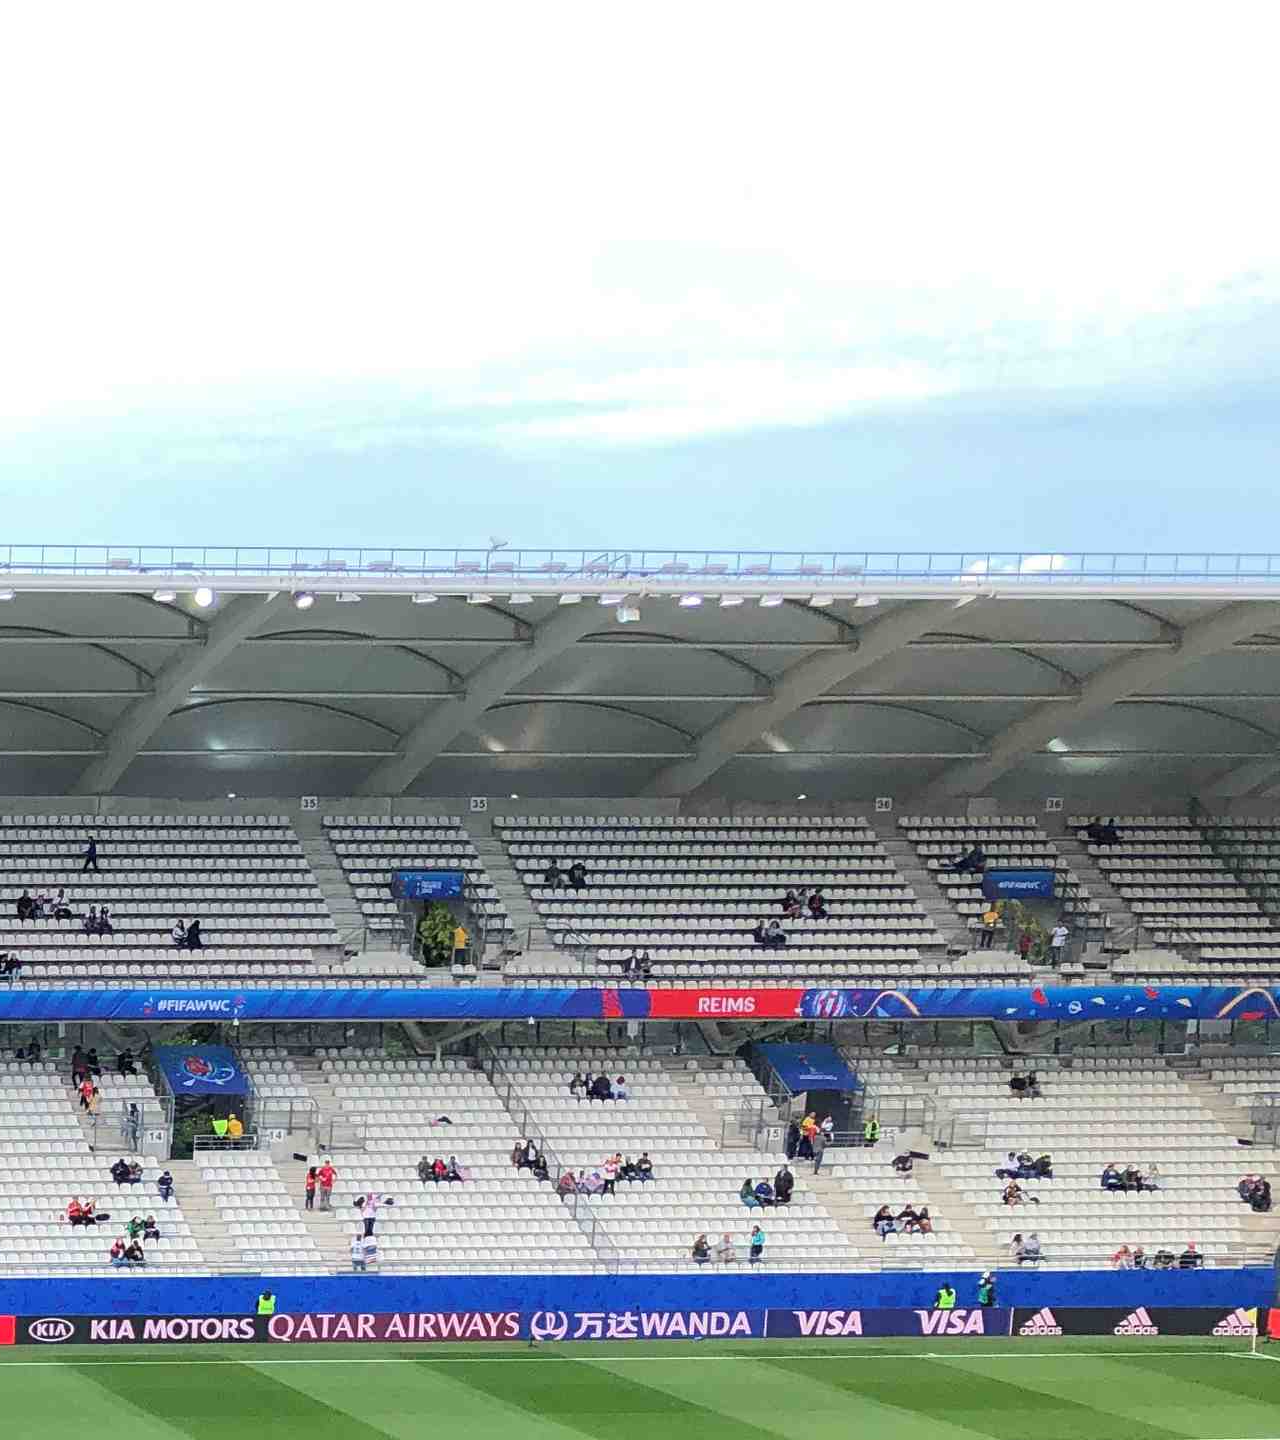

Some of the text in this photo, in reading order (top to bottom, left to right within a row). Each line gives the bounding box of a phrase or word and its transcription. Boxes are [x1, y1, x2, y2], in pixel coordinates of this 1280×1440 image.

[303, 798, 317, 807] 35
[472, 799, 486, 808] 35
[158, 999, 230, 1013] #FIFAWWC
[698, 997, 755, 1013] REIMS
[149, 1132, 162, 1141] 14
[269, 1131, 282, 1140] 14
[268, 1312, 520, 1341] QATAR AIRWAYS
[791, 1310, 862, 1337] VISA
[915, 1309, 985, 1335] VISA
[37, 1323, 67, 1337] KIA
[91, 1318, 254, 1340] KIA MOTORS
[1019, 1325, 1063, 1336] adidas
[1114, 1325, 1159, 1336] adidas
[1212, 1326, 1258, 1336] adidas
